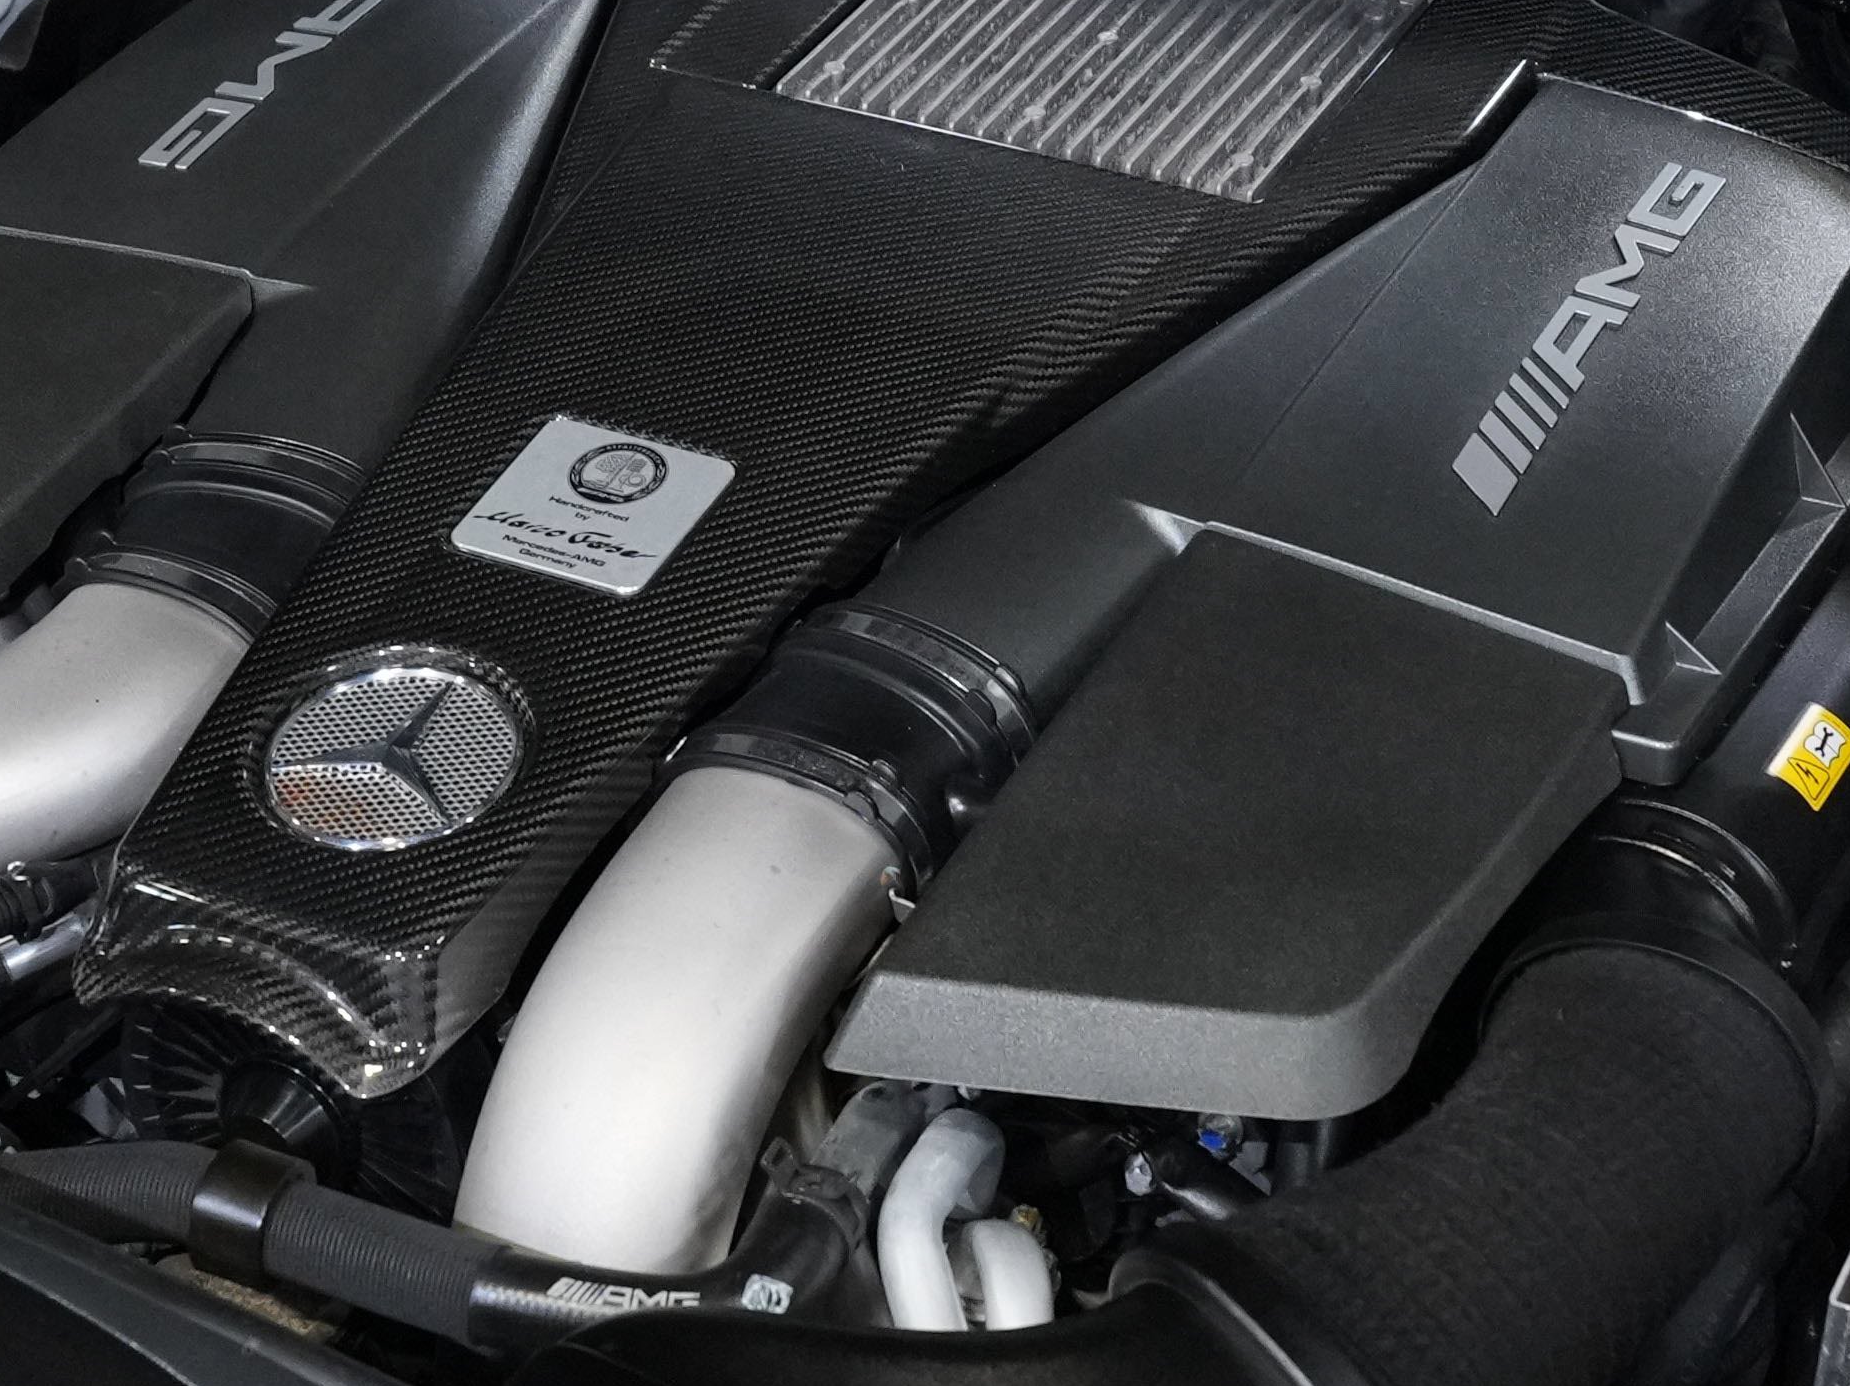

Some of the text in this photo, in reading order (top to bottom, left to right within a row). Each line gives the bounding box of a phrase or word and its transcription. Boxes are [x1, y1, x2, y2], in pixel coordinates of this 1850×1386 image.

[549, 495, 630, 523] Handcrafted
[574, 511, 590, 522] by
[502, 534, 606, 568] Mercedes-AMG
[518, 547, 577, 569] Germany
[595, 1284, 701, 1310] AMG
